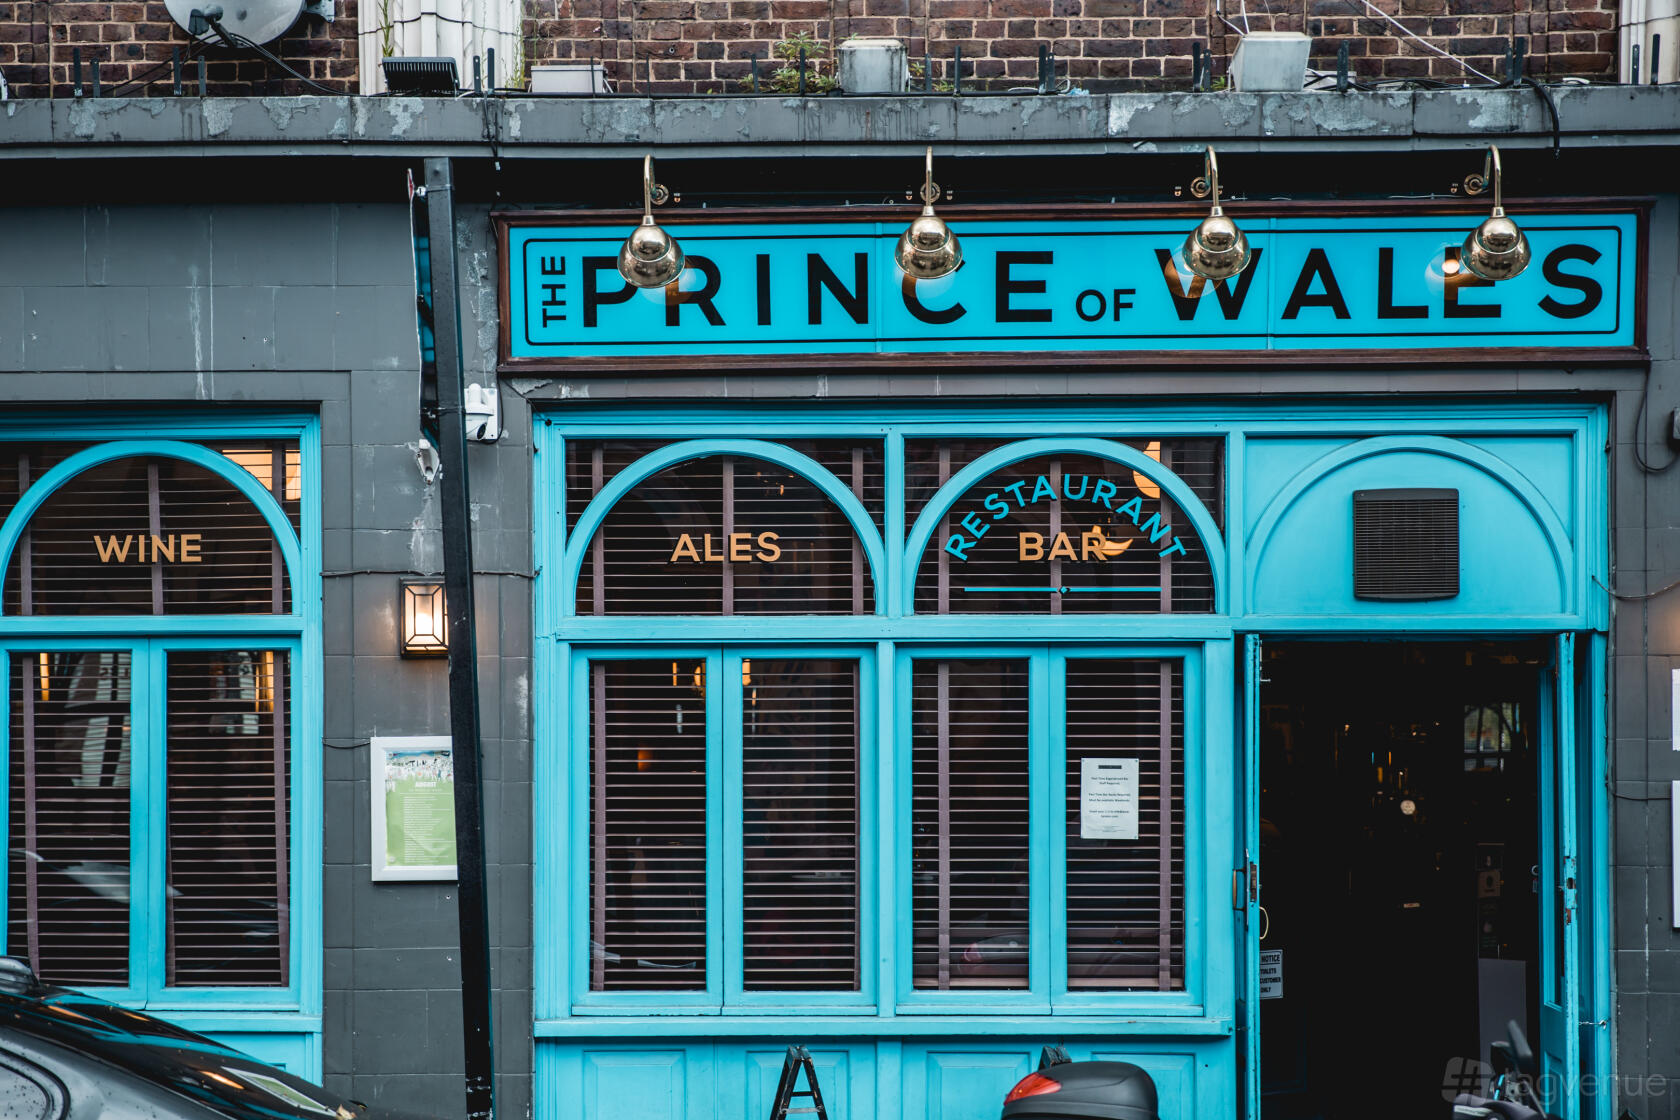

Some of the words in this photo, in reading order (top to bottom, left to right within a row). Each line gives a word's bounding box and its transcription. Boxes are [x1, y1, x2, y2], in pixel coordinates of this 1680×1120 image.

[542, 255, 566, 328] THE
[581, 250, 1054, 328] PRINCE
[1075, 289, 1136, 322] OF
[1154, 243, 1603, 322] WALES
[944, 473, 1188, 562] RESTAURANT
[93, 533, 202, 563] WINE
[670, 531, 781, 562] ALES
[1018, 531, 1108, 561] BAR
[1261, 954, 1281, 963] NOTICE
